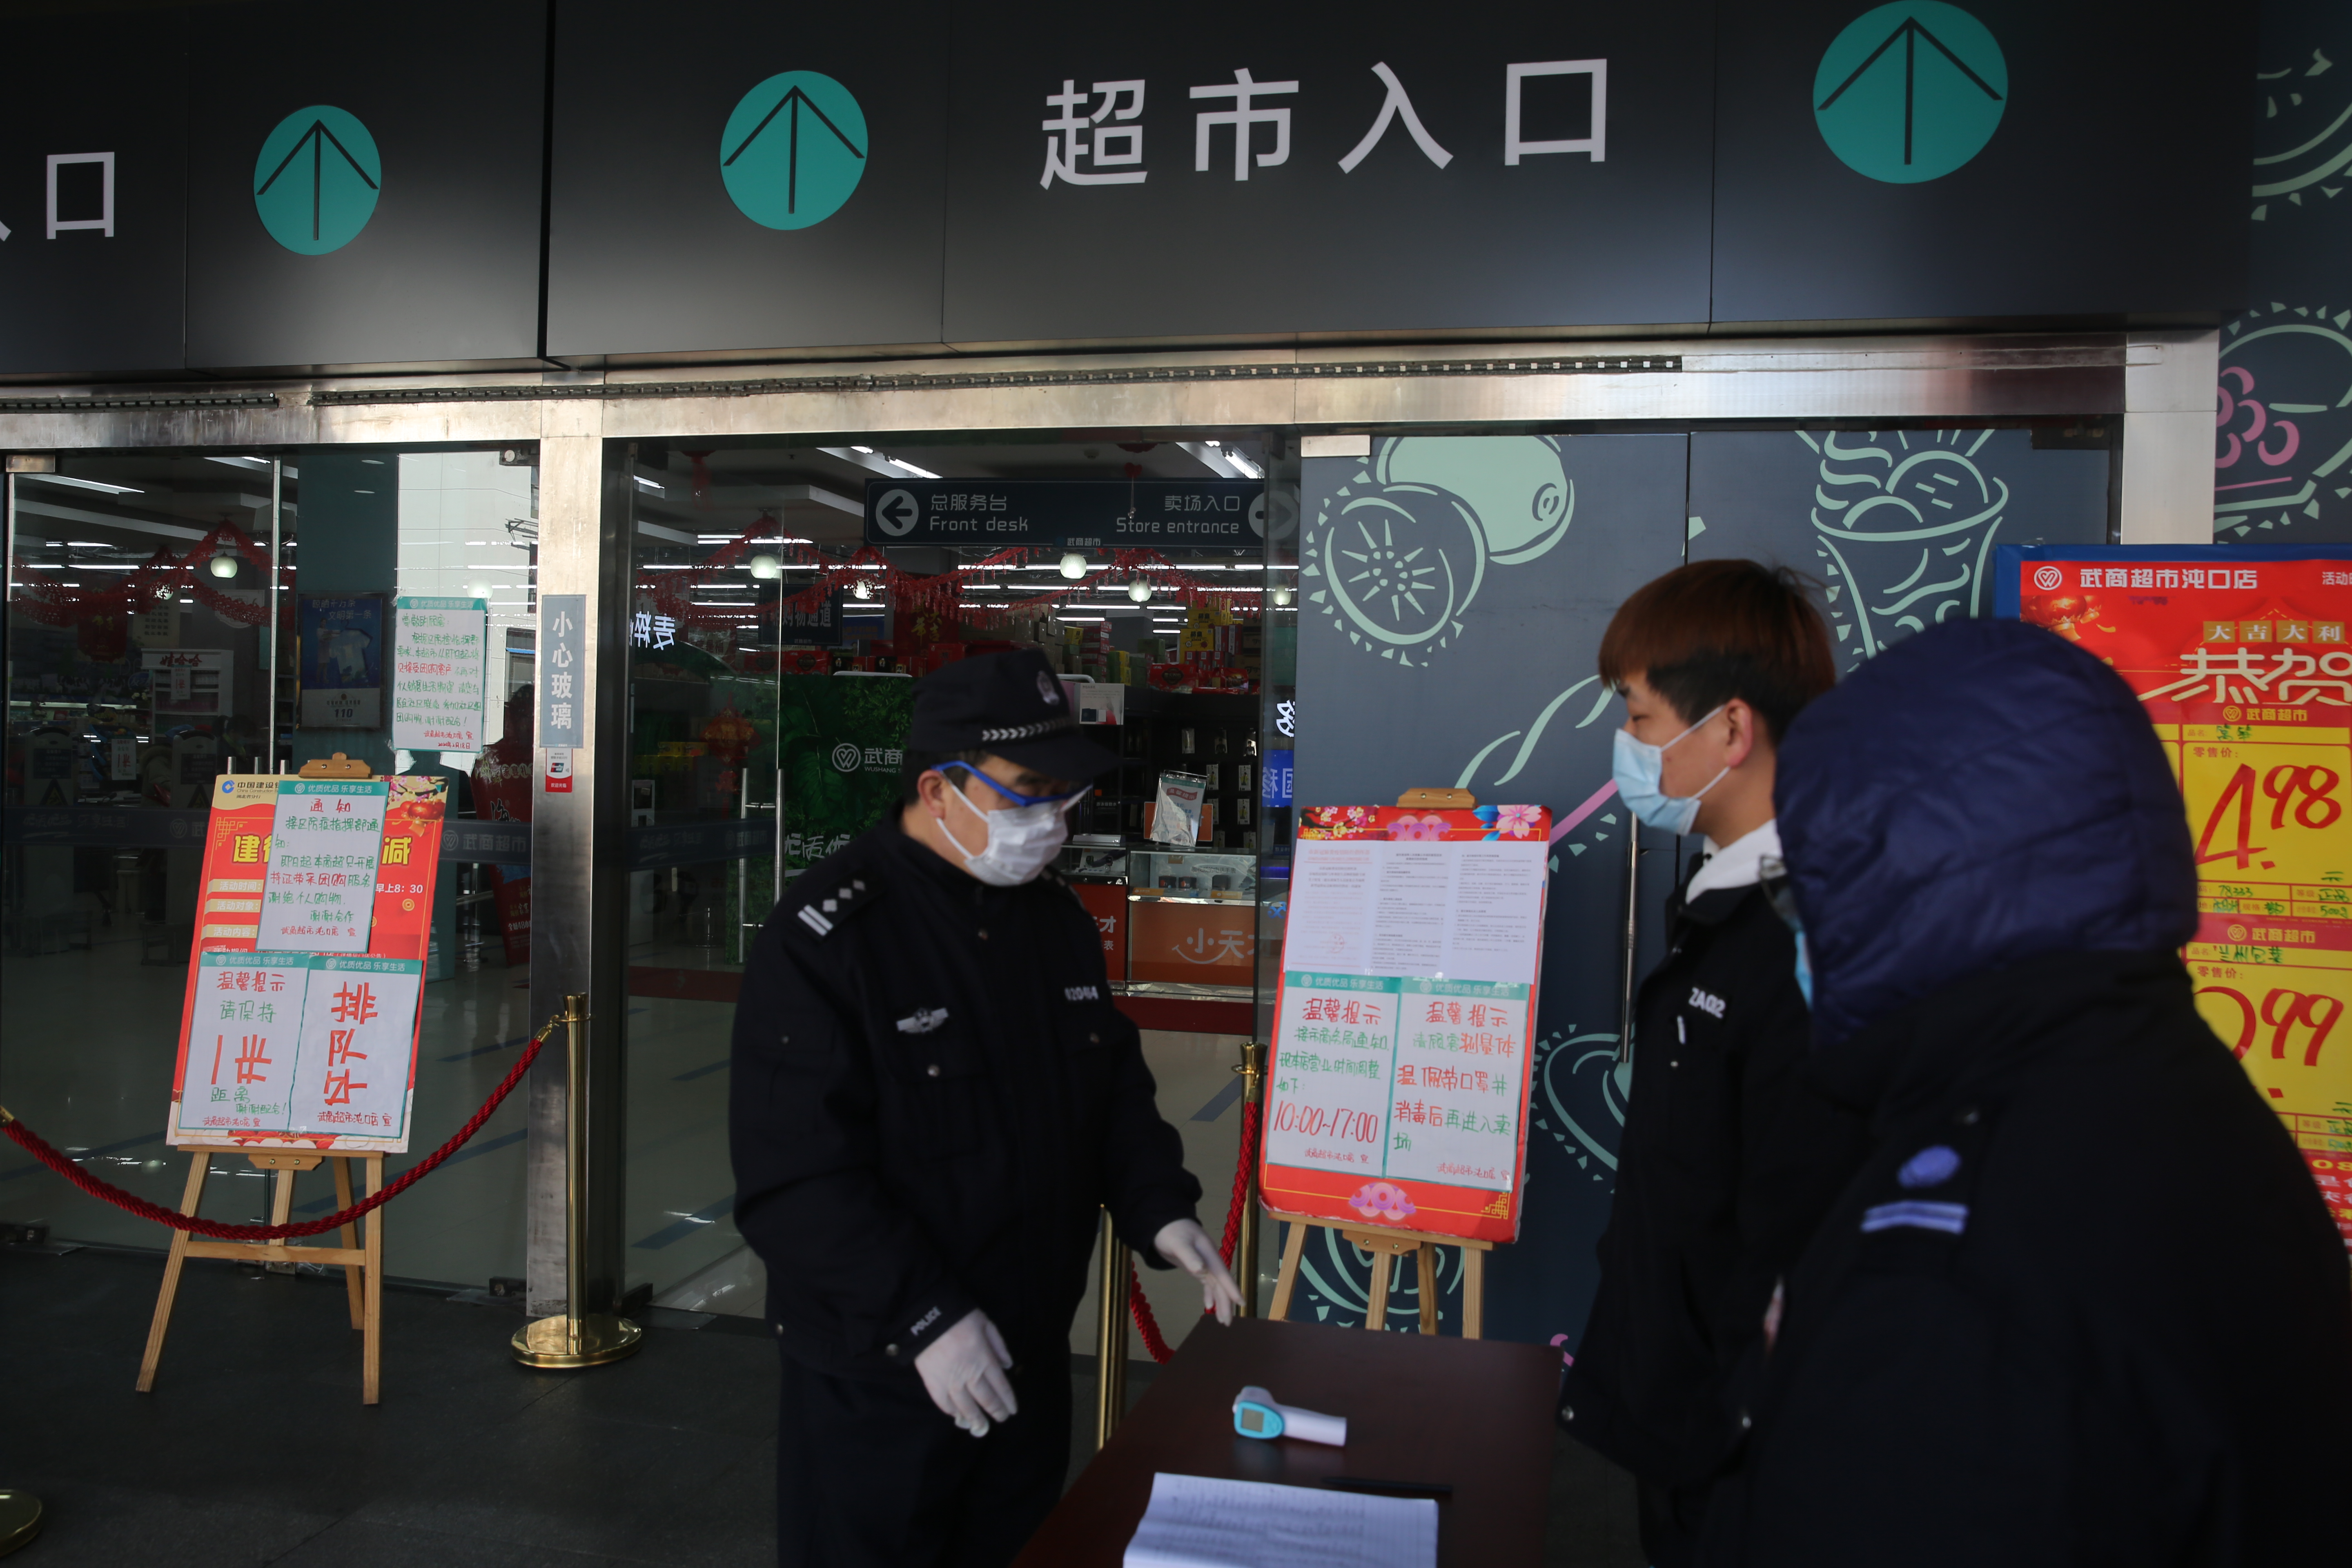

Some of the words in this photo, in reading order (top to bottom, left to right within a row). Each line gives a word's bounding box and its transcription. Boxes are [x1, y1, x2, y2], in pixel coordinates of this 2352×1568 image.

[1040, 58, 1607, 190] 超市入口
[931, 494, 1007, 511] 总服务台
[1165, 494, 1240, 512] 卖场入口
[930, 517, 977, 532] Front
[986, 516, 1028, 532] desk
[1116, 517, 1160, 533] Store
[1167, 519, 1239, 534] entrance
[1067, 538, 1101, 546] 武商超市
[2080, 568, 2258, 589] 武商超市沌口店
[421, 600, 446, 608] 优质优品
[448, 600, 474, 608] 乐享生活
[328, 609, 372, 620] 文明第一条
[2208, 624, 2341, 642] 大吉大利
[160, 653, 203, 667] 娃哈哈
[551, 611, 573, 729] 小心玻璃
[2137, 647, 2352, 706] 恭贺
[334, 708, 353, 718] 110
[2246, 708, 2307, 722] 武商超市
[308, 784, 339, 793] 优质优品
[341, 785, 372, 793] 乐享生活
[310, 798, 351, 813] 通知
[381, 836, 412, 865] 减
[463, 833, 527, 852] 武商超市
[219, 880, 261, 891] 活动时间：
[217, 900, 258, 911] 活动对象：
[213, 926, 255, 937] 活动内容：
[2252, 928, 2315, 943] 武商超市
[229, 956, 261, 965] 优质优品
[263, 957, 294, 966] 乐享生活
[339, 960, 372, 970] 优质优品
[373, 961, 405, 971] 乐享生活
[216, 971, 286, 993] 温馨提示
[1315, 975, 1348, 988] 优质优品
[1350, 978, 1384, 991] 乐享生活
[1435, 982, 1470, 994] 优质优品
[220, 1000, 277, 1023] 请保持
[1302, 997, 1381, 1025] 温馨提示
[1425, 1001, 1508, 1028] 温馨提示
[210, 1086, 250, 1102] 距离
[383, 1112, 392, 1127] 宣
[1393, 1132, 1412, 1152] 场
